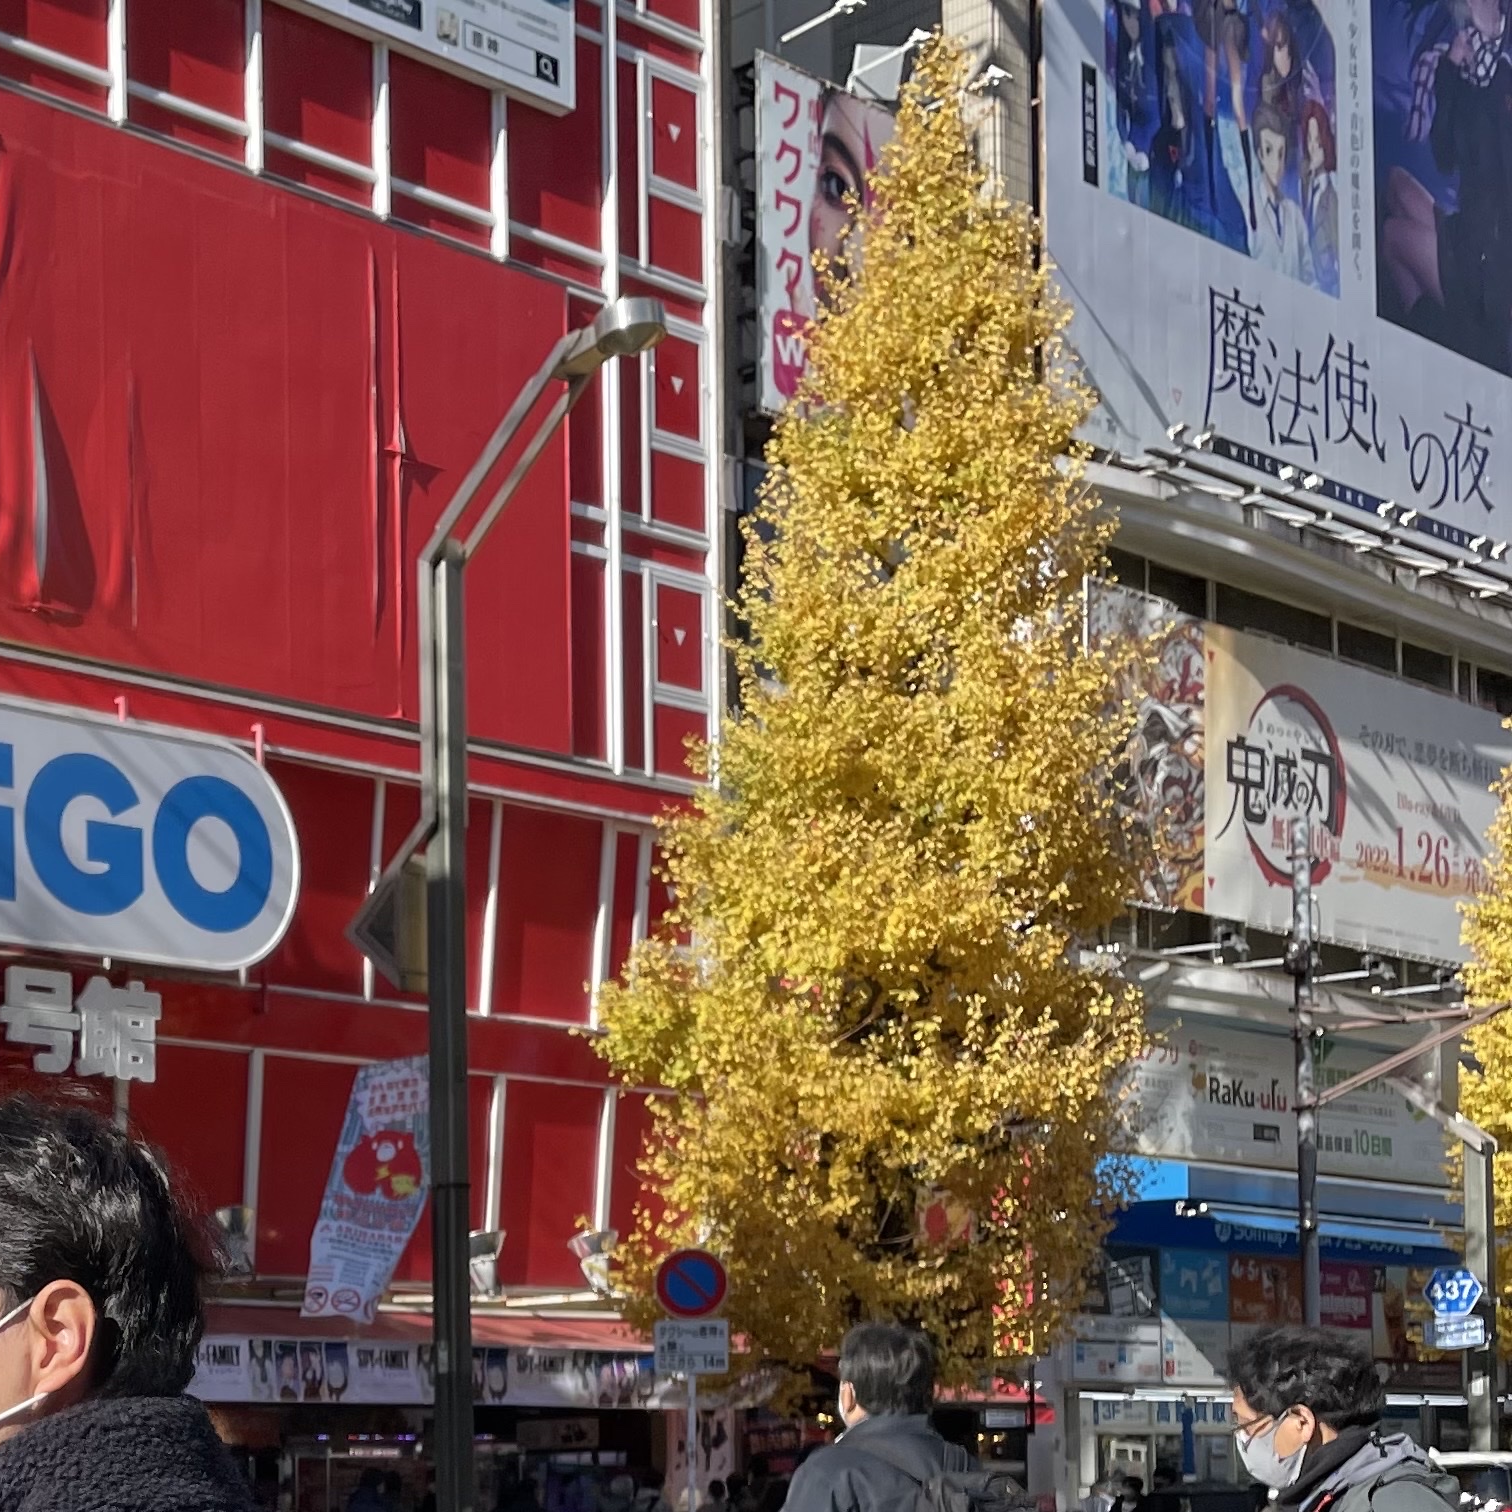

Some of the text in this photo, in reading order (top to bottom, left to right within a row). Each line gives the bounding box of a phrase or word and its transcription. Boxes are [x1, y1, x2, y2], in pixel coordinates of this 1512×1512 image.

[774, 80, 803, 292] ワクワク
[1204, 284, 1495, 514] 魔法使いの夜
[1215, 732, 1341, 842] 鬼滅の刃
